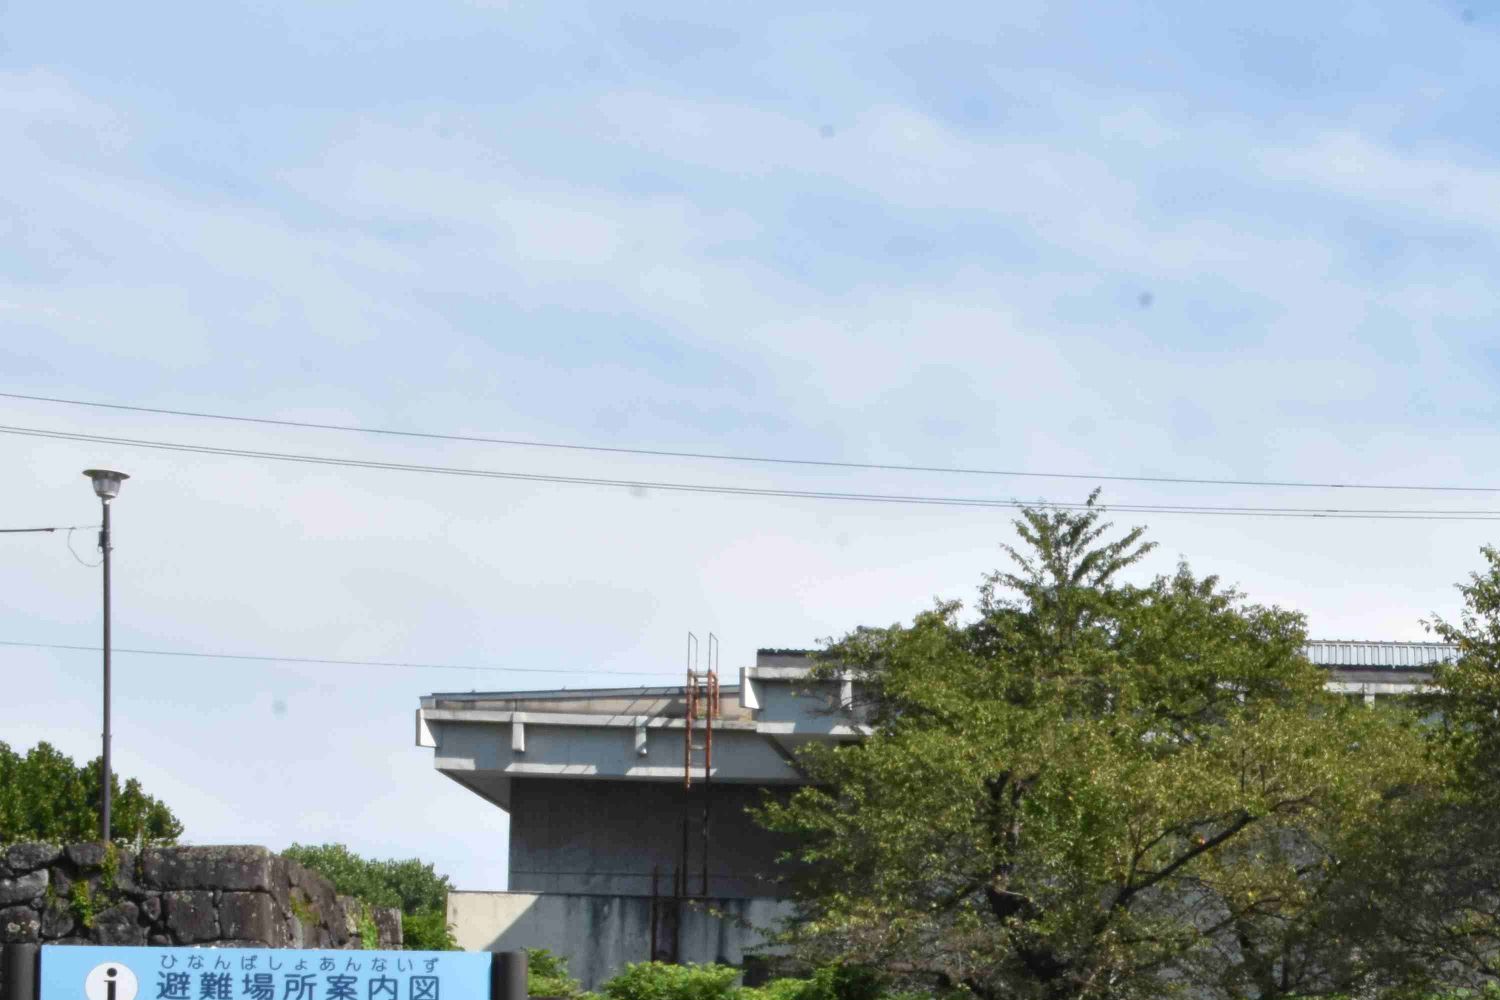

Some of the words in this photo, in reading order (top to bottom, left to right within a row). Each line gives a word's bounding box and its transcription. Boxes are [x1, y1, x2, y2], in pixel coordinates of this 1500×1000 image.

[161, 954, 440, 973] ひなんばしょあんないず
